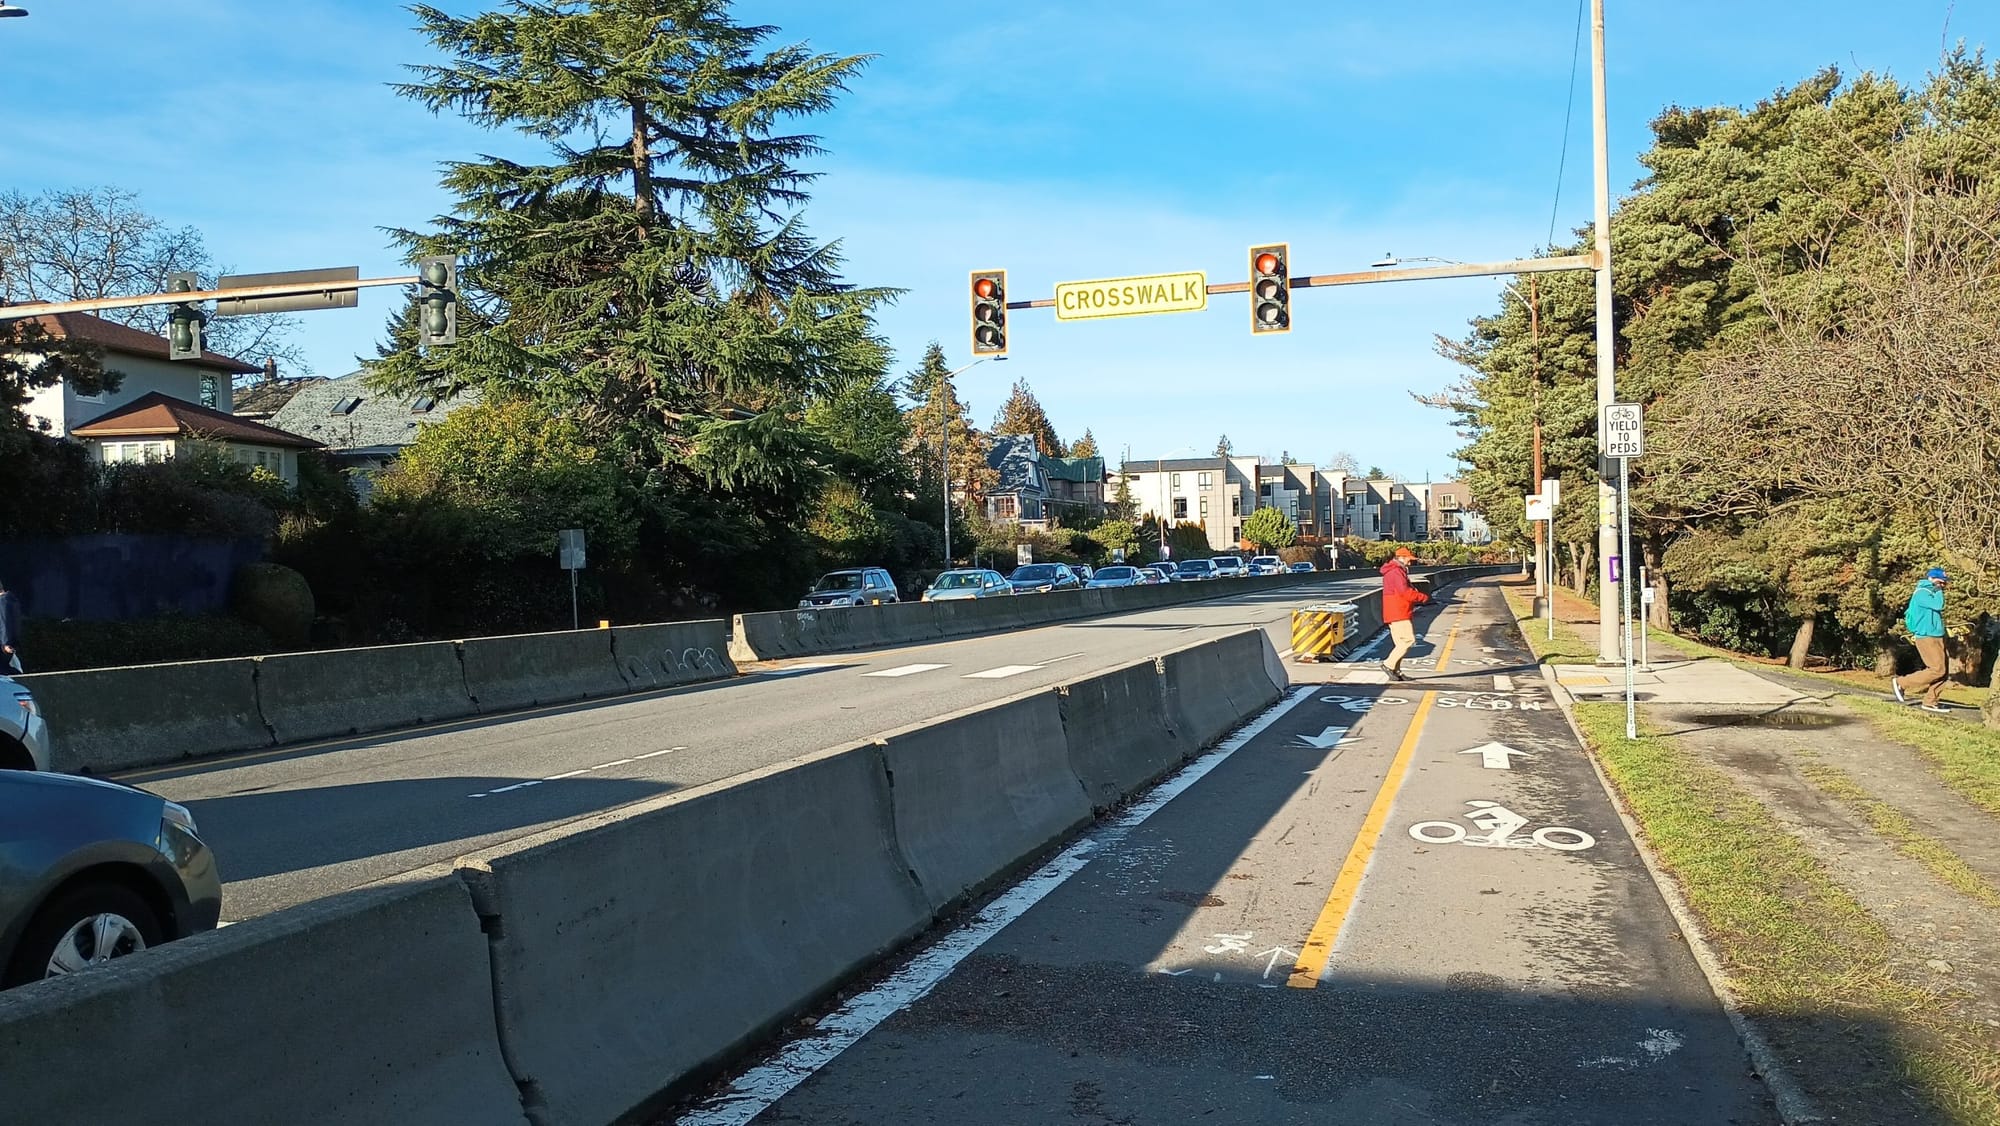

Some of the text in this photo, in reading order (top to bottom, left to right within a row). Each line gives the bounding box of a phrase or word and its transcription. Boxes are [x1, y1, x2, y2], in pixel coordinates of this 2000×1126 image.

[1063, 280, 1198, 311] CROSSWALK
[1609, 420, 1638, 431] YIELD
[1618, 432, 1630, 442] TO
[1610, 442, 1638, 453] PEDS
[1366, 657, 1437, 666] SLW
[1437, 697, 1541, 711] SLOW
